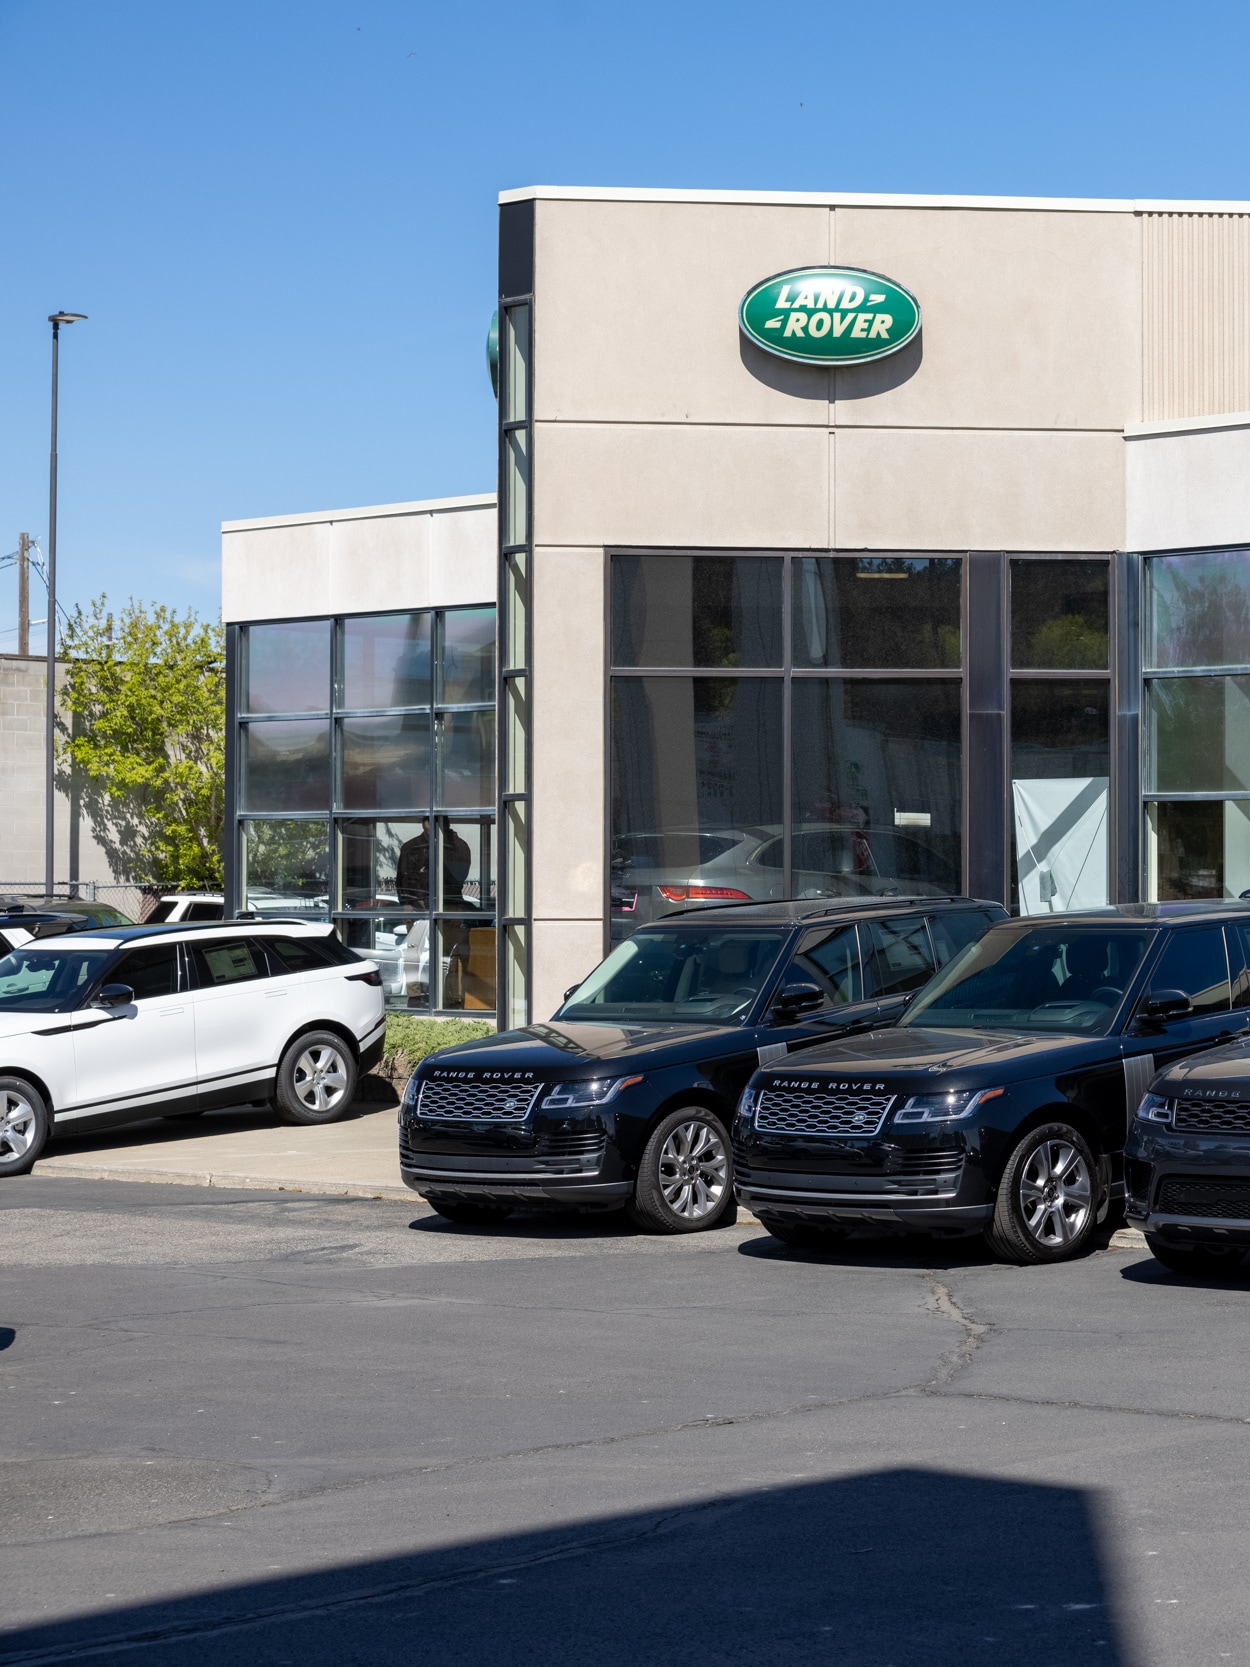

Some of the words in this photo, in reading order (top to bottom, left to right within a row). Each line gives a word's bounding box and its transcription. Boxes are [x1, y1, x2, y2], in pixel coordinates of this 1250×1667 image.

[774, 284, 865, 309] LAND
[782, 311, 894, 339] ROVER
[433, 1070, 475, 1079] RANGE
[772, 1079, 819, 1089] RANGE
[828, 1082, 885, 1090] ROVER
[1183, 1088, 1240, 1098] RANGE
